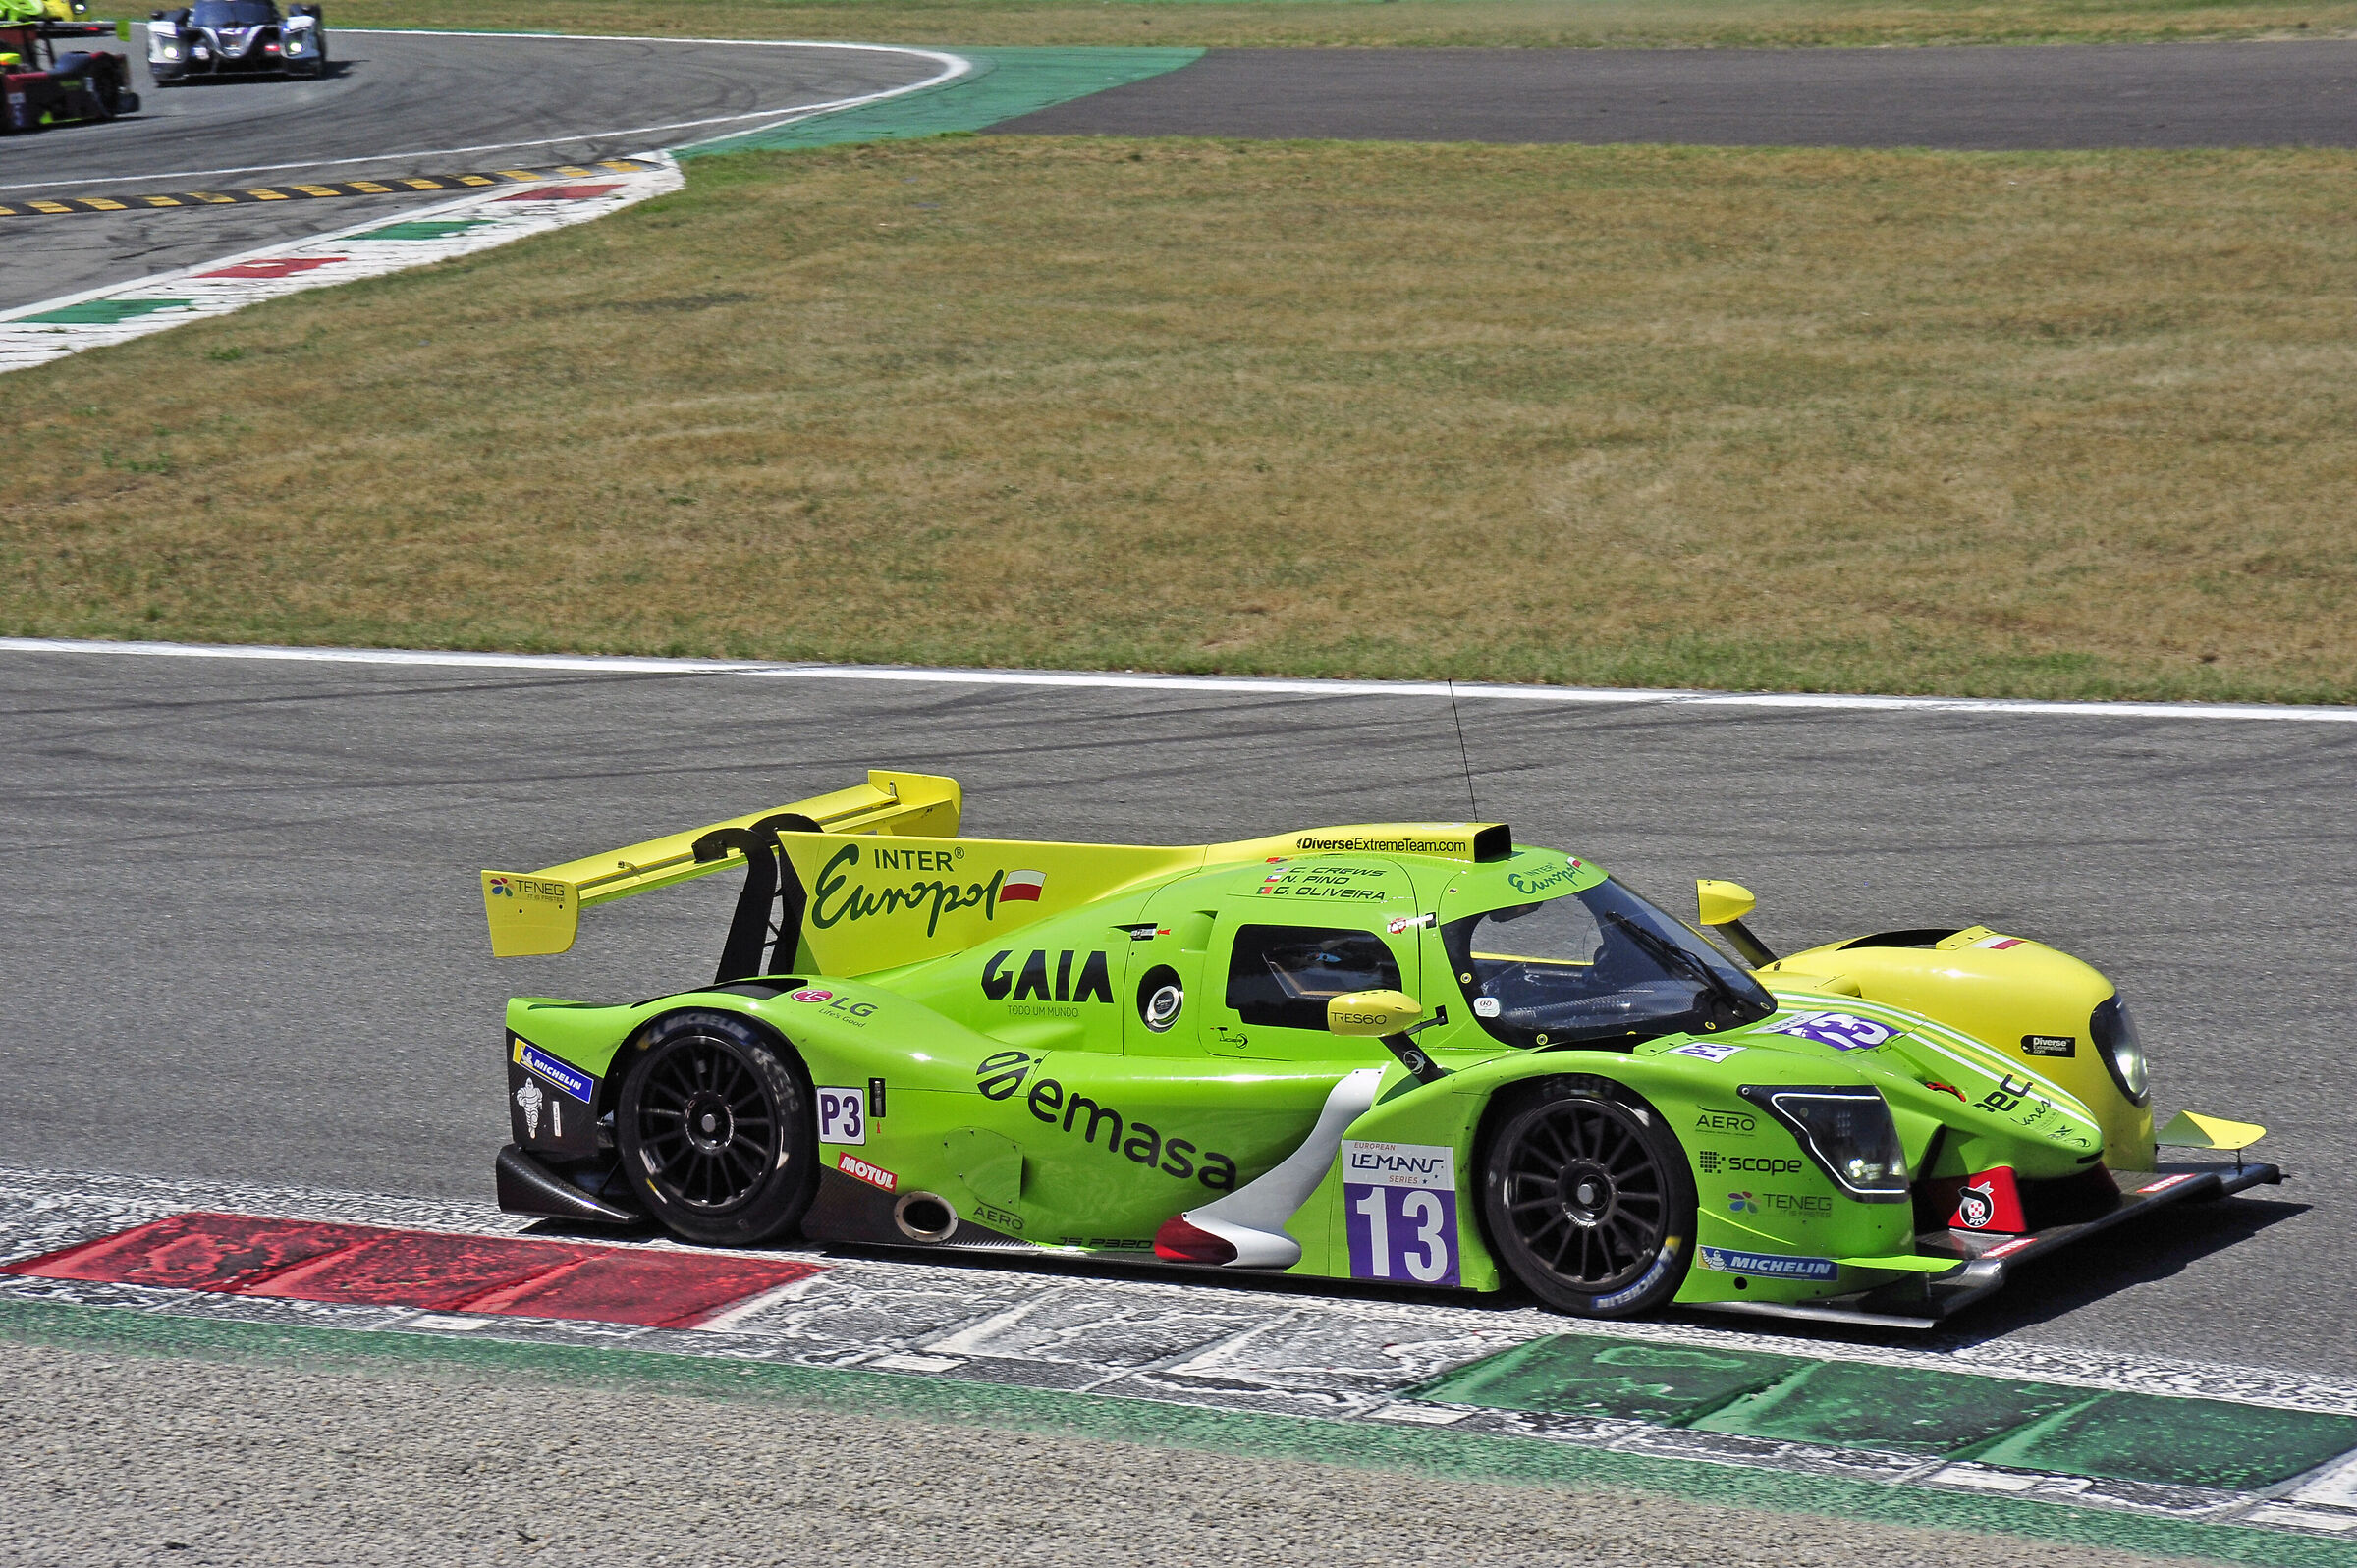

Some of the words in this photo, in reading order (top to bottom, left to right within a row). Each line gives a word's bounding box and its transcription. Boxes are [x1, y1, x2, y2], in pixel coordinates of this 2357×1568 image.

[1281, 875, 1296, 884] N.
[1302, 875, 1350, 885] PINO
[1311, 867, 1388, 877] CREWS
[1508, 861, 1585, 894] Europol
[515, 880, 565, 896] TENEG
[811, 843, 1005, 938] Europol
[1295, 887, 1386, 900] OLIVEIRA
[981, 949, 1115, 1004] GAIA
[829, 997, 879, 1018] LG
[1007, 1005, 1030, 1016] TODO
[1033, 1005, 1046, 1016] UM
[1047, 1006, 1079, 1018] MUNDO
[842, 1016, 867, 1028] Good
[1678, 1044, 1734, 1058] P3
[2033, 1037, 2067, 1047] Diverse
[534, 1059, 582, 1091] MICHELIN
[820, 1094, 861, 1138] P3
[1696, 1114, 1755, 1131] AERO
[1027, 1078, 1237, 1191] emasa
[1354, 1142, 1396, 1151] EUROPEAN
[841, 1156, 894, 1188] MOTUL
[1729, 1157, 1802, 1176] scope
[1389, 1175, 1418, 1184] SERIES
[1763, 1193, 1832, 1211] TENEG
[973, 1206, 1024, 1230] AERO
[1356, 1186, 1448, 1282] 13
[1730, 1256, 1832, 1274] MICHELIN
